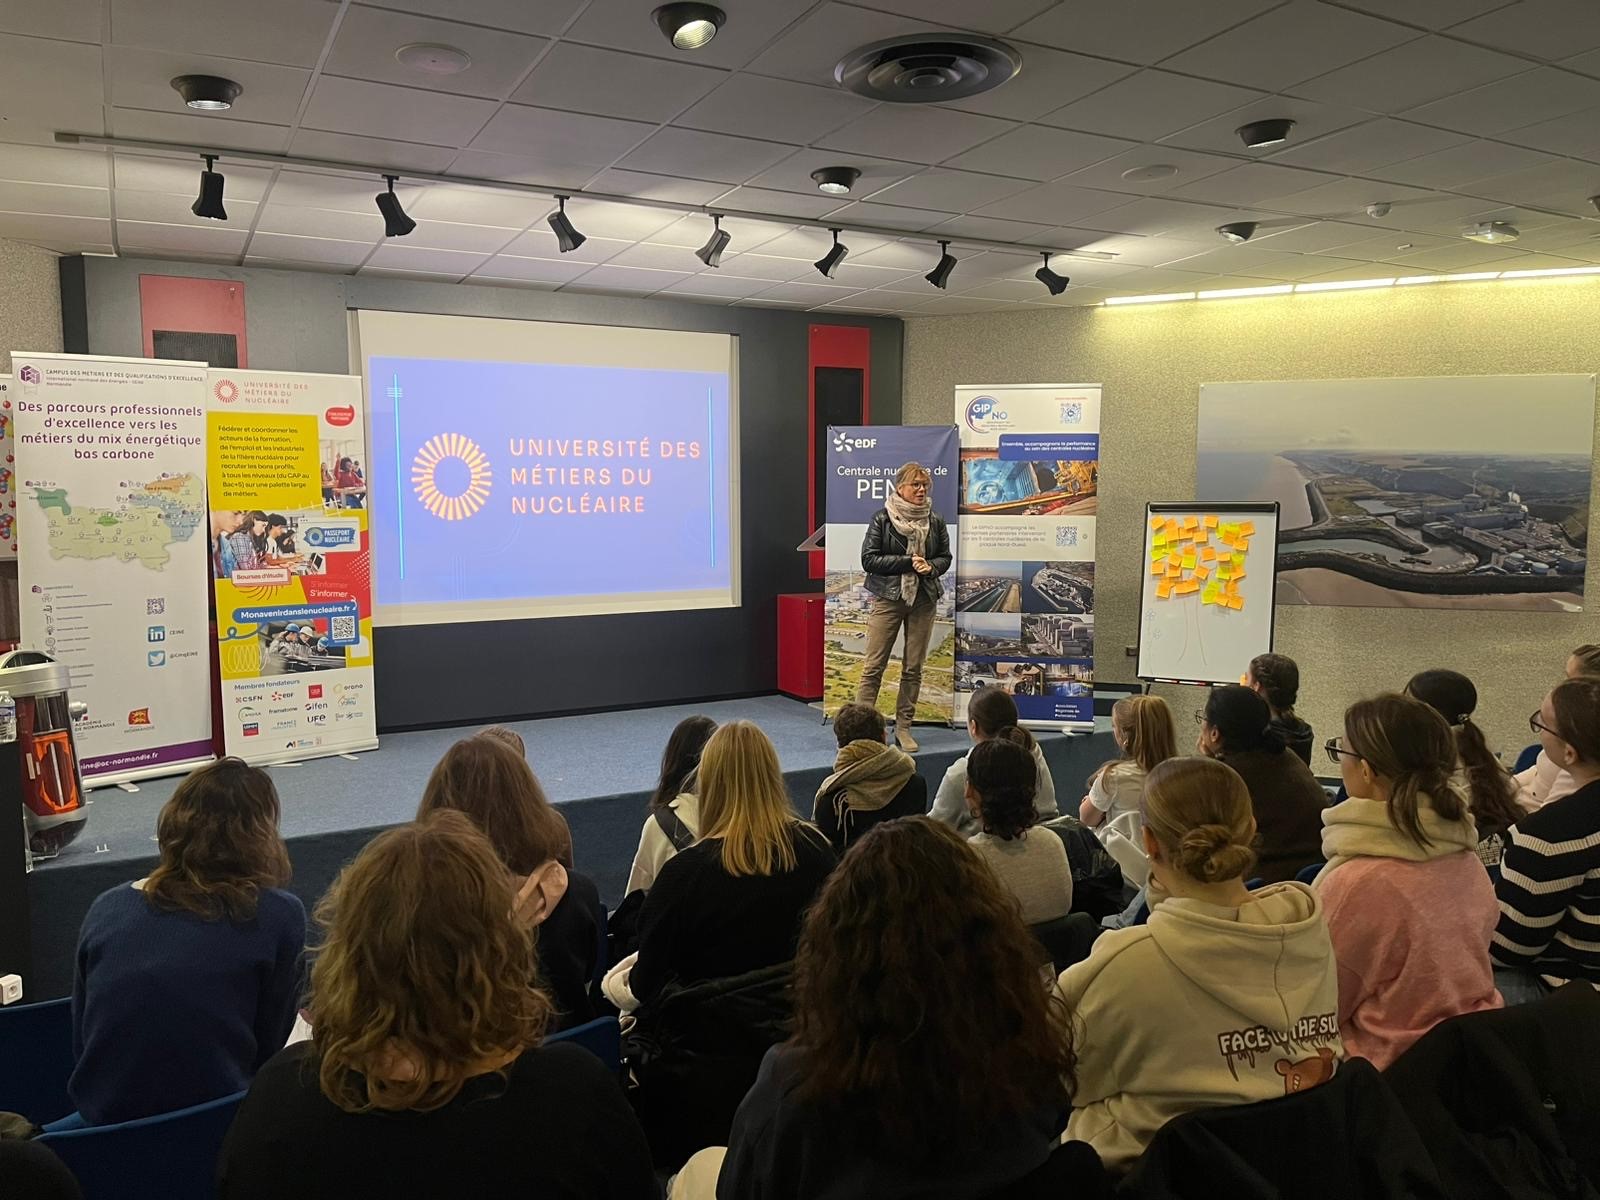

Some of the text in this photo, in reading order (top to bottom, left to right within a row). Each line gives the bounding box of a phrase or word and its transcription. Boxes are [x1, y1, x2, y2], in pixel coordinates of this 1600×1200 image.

[243, 381, 291, 390] UNIVERSITÉ
[244, 388, 278, 396] MÉTIERS
[245, 396, 289, 404] NUCLÉAIRE
[18, 401, 202, 416] Des parcours professionnels
[972, 403, 991, 413] GIP
[992, 411, 1008, 420] NO
[44, 418, 177, 430] d'excellence vers les
[218, 425, 243, 433] Fédérer
[21, 433, 201, 447] métiers du mix énergétique
[509, 437, 701, 459] UNIVERSITÉ DES
[74, 449, 154, 459] bas carbone
[511, 464, 653, 486] MÉTIERS DU
[837, 465, 881, 476] Centrale
[933, 465, 948, 476] de
[511, 493, 646, 514] NUCLÉAIRE
[324, 535, 350, 543] NUCLÉAIRE
[310, 589, 348, 598] S'informer
[265, 679, 300, 688] fondateurs
[1218, 1026, 1271, 1056] FACE
[1318, 1012, 1340, 1035] SU
